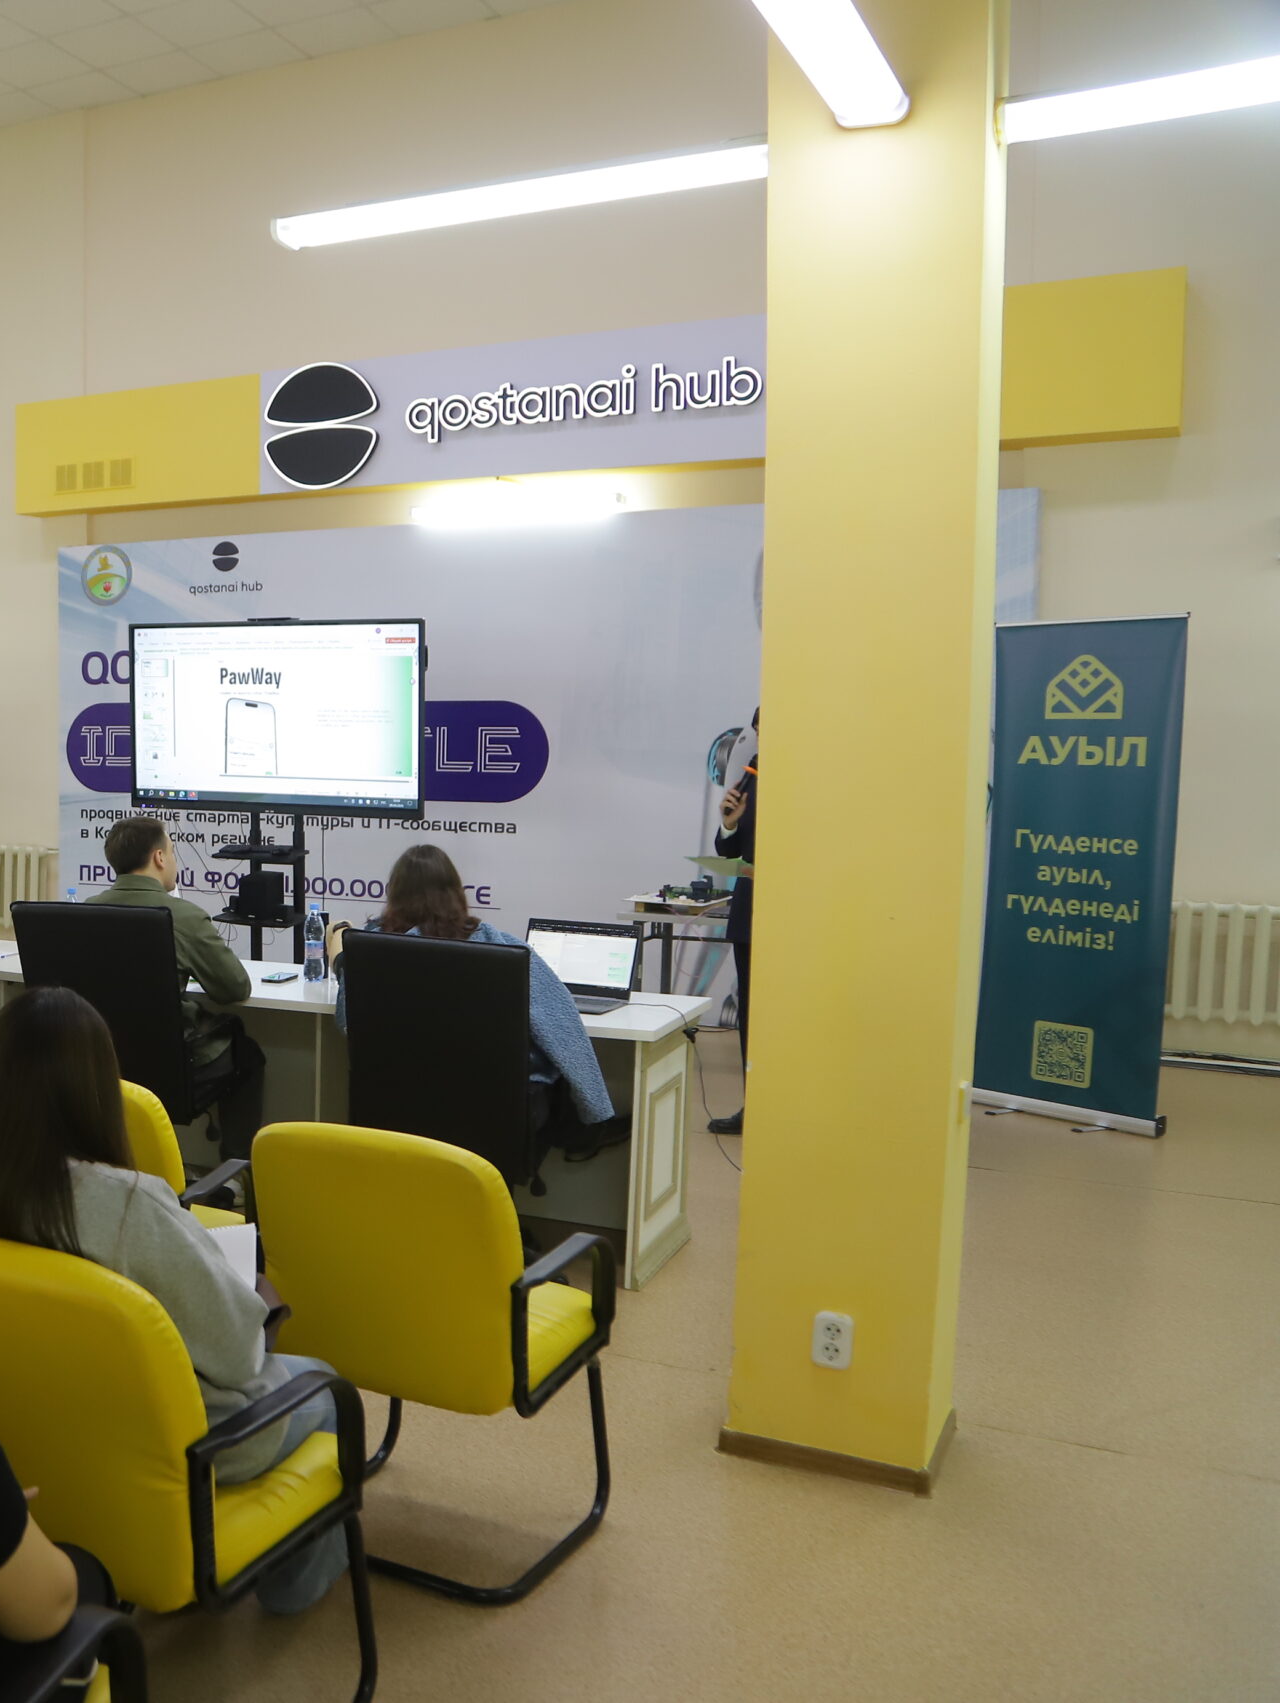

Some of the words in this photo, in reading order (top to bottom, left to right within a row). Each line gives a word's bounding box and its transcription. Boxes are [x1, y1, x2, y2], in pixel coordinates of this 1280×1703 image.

[406, 365, 636, 442] qostanai
[651, 356, 762, 412] hub
[189, 581, 238, 596] qostanai
[242, 581, 263, 593] hub
[220, 667, 282, 689] PawWay
[424, 726, 521, 773] LE
[1017, 735, 1148, 767] АУЫЛ
[80, 828, 90, 839] в
[186, 810, 354, 830] старта-културы
[1015, 828, 1139, 855] Гүлденсе
[1036, 864, 1112, 890] ауыл,
[1006, 893, 1141, 924] гүлденеді
[1026, 924, 1115, 951] еліміз!
